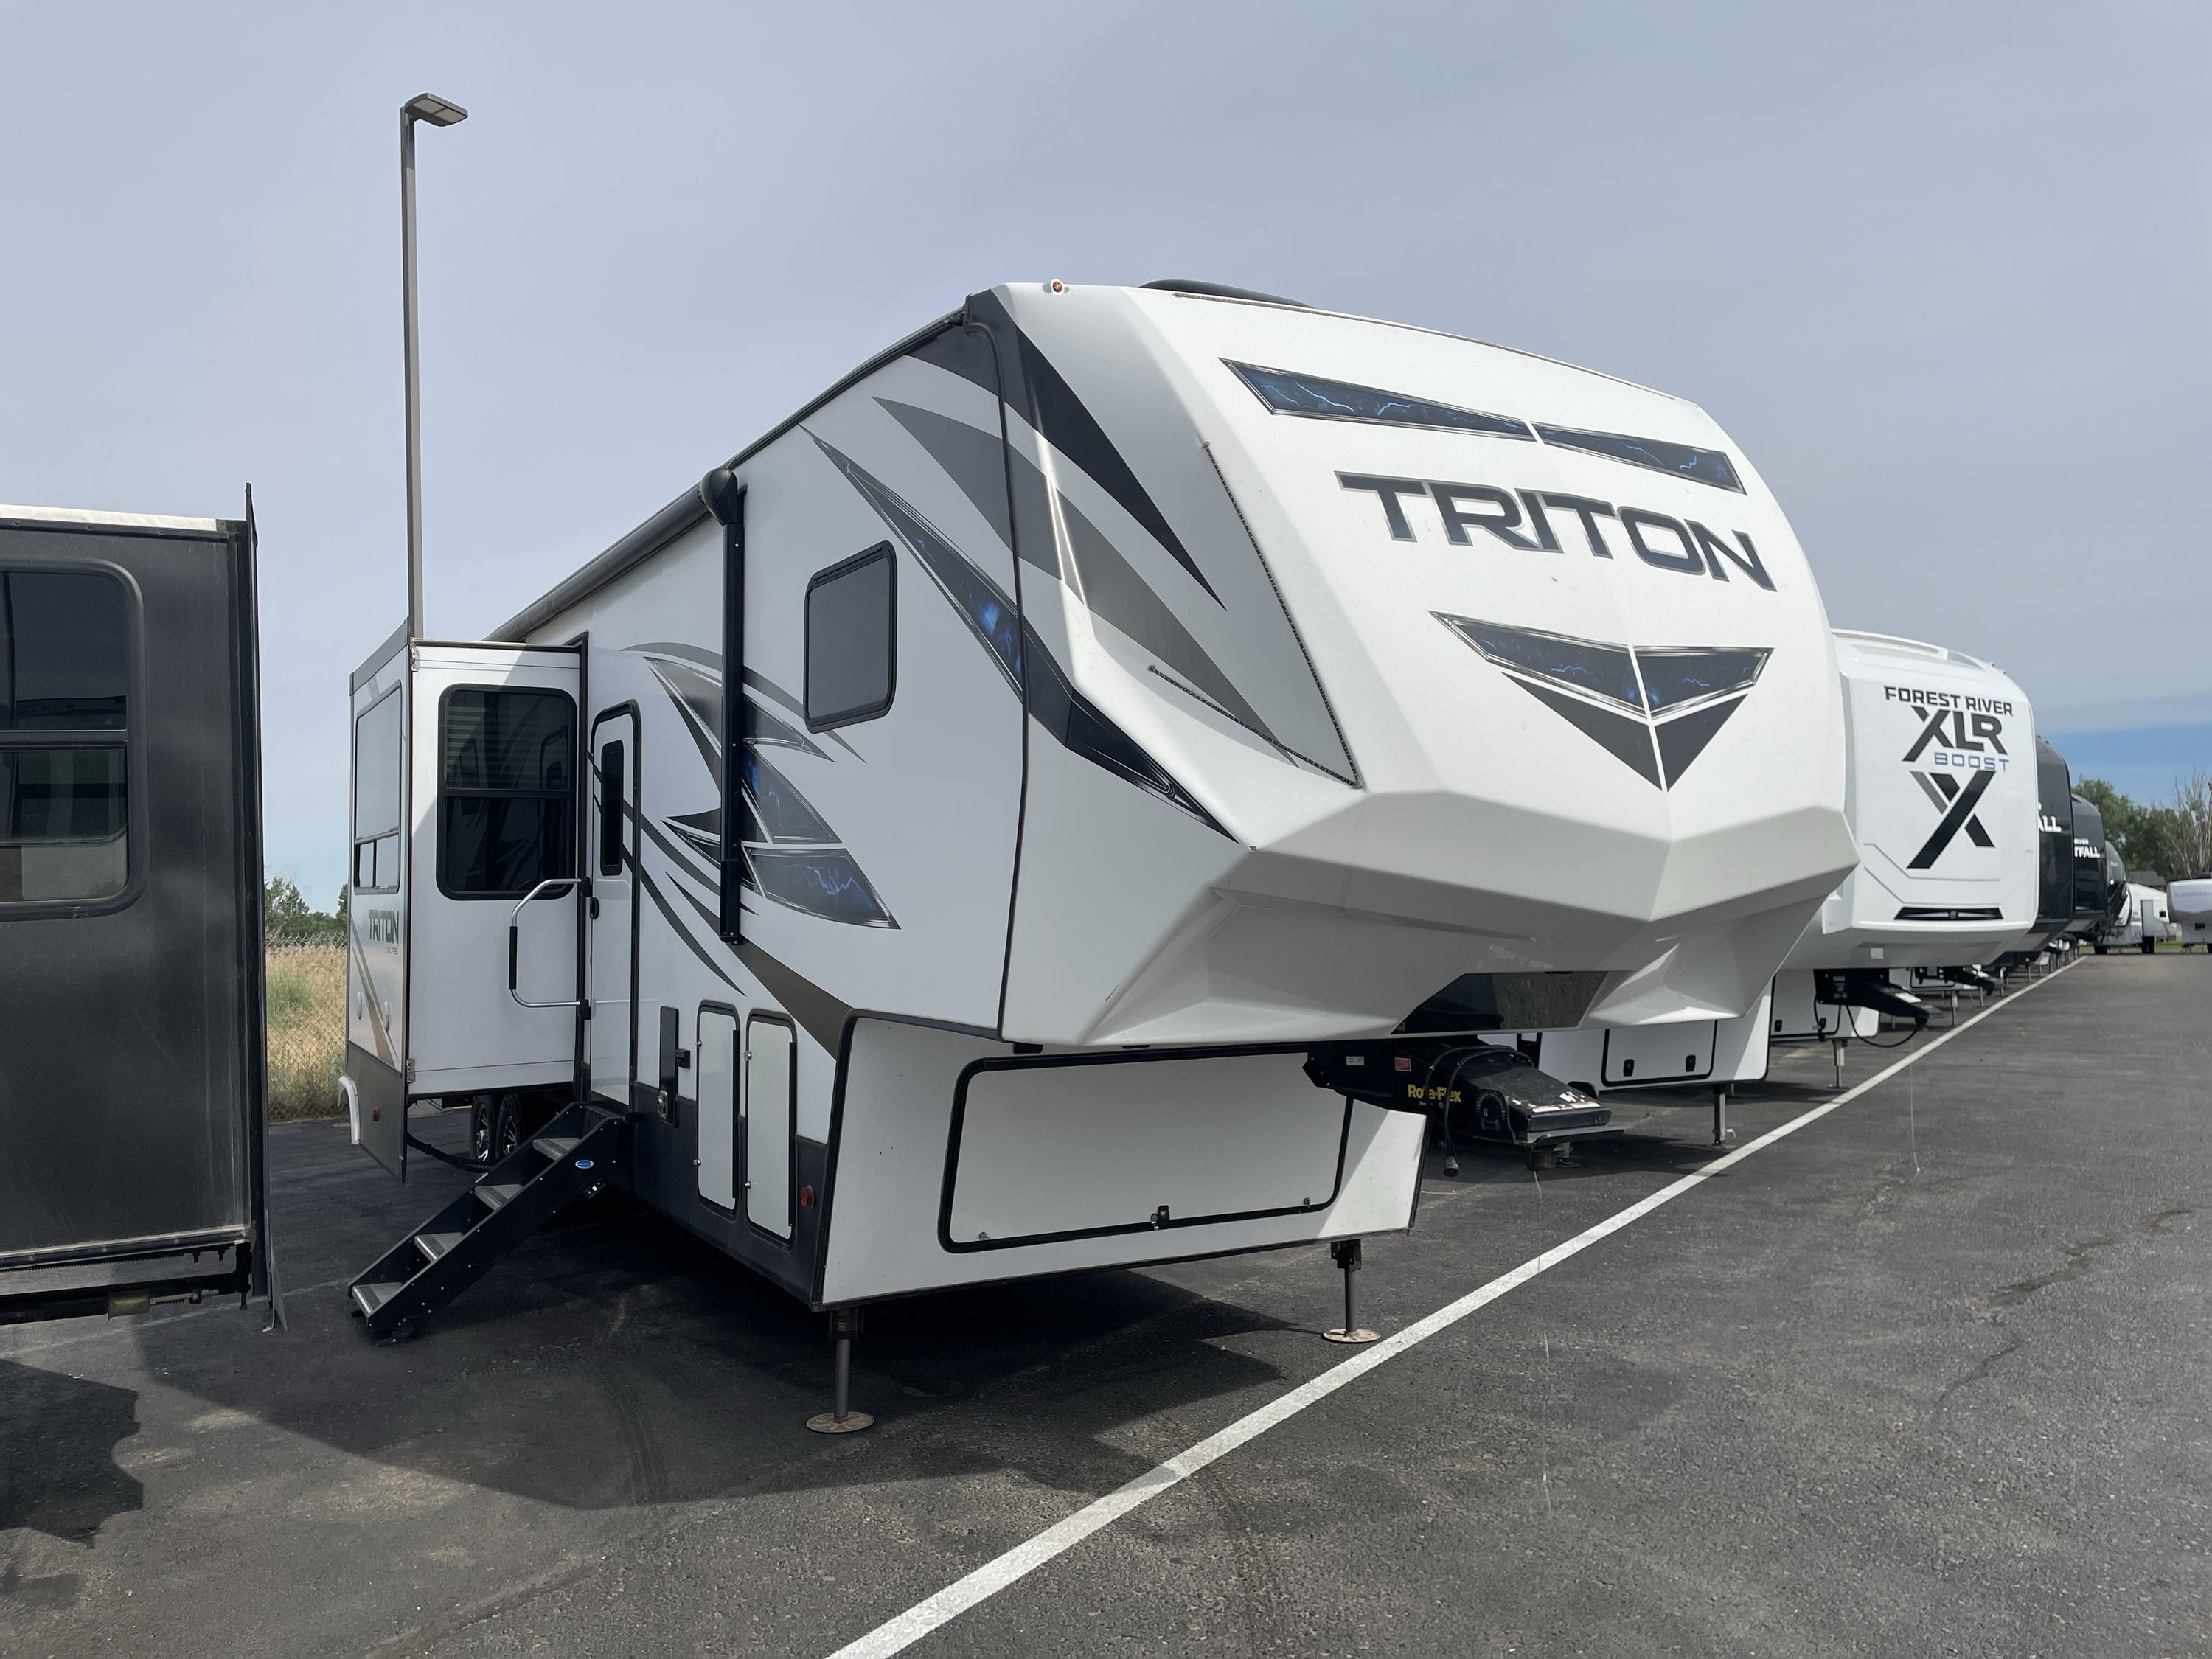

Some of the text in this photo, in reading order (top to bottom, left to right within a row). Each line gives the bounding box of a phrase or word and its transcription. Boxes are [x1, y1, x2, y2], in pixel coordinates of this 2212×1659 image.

[1334, 470, 1778, 593] TRITON
[1884, 686, 2013, 717] FOREST RIVER
[1902, 705, 2008, 762] XLR
[1935, 752, 2009, 771] BOOST
[369, 910, 400, 945] TRITON
[1408, 1084, 1462, 1103] Roa-Fex
